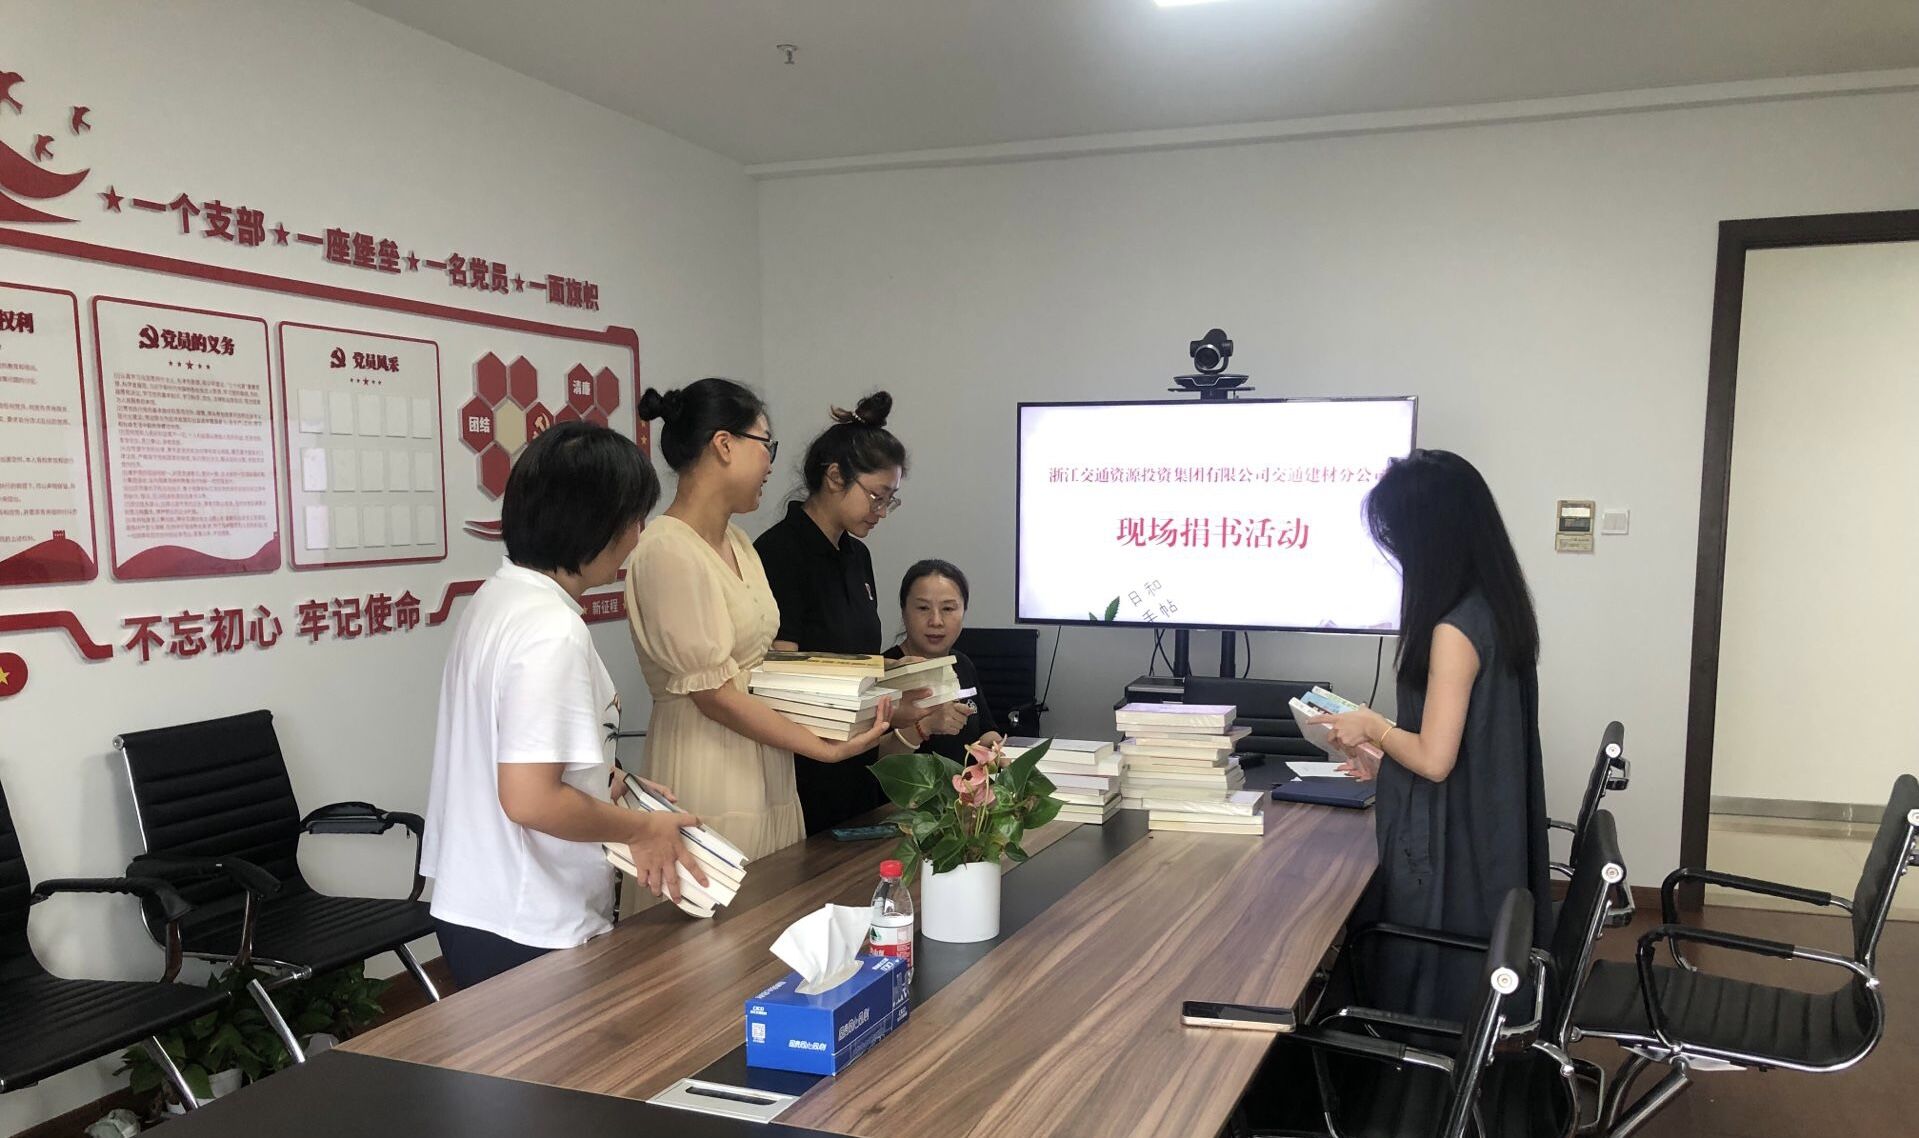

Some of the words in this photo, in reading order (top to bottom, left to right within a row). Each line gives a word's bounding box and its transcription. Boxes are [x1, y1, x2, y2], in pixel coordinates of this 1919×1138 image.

[132, 193, 266, 246] 一个支部
[297, 227, 401, 274] 一座堡垒
[425, 252, 509, 295] 一名党员
[528, 274, 599, 311] 一面旗帜
[161, 329, 235, 356] 党员的义务
[352, 352, 399, 373] 党员风采
[572, 379, 591, 396] 清廉
[468, 416, 491, 433] 团结
[1116, 516, 1309, 550] 现场捐书活动
[1128, 579, 1162, 607] 日和
[592, 598, 618, 616] 新征程
[123, 604, 282, 662] 不忘初心
[298, 590, 421, 642] 牢记使命
